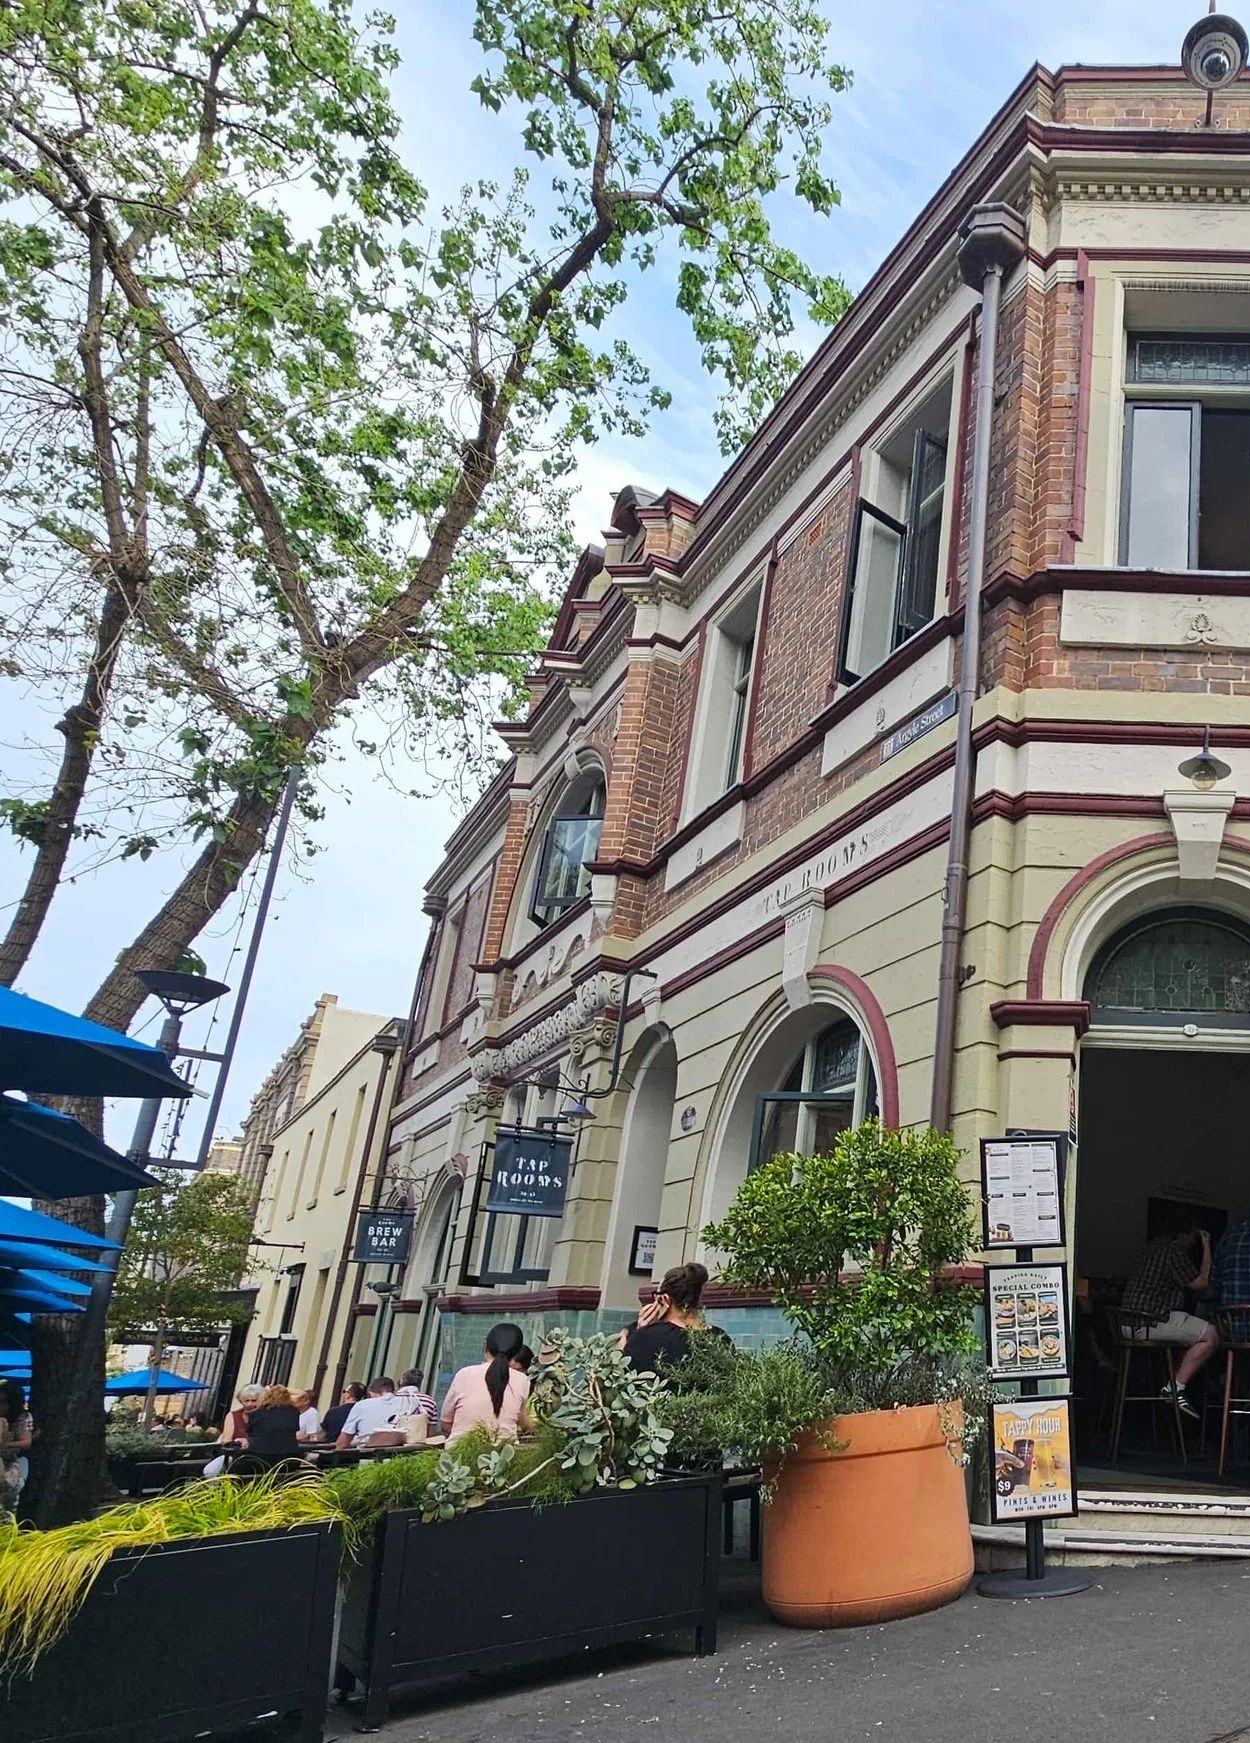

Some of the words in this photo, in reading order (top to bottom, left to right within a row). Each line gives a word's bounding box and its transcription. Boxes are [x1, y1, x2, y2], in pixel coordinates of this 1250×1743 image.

[921, 704, 944, 729] Street
[763, 882, 791, 914] TAP
[801, 832, 869, 890] ROOMS
[516, 1157, 548, 1172] TAP
[497, 1170, 562, 1188] ROOMS
[368, 1226, 403, 1236] BREW
[371, 1236, 396, 1247] BAR
[993, 1283, 1028, 1292] SPECIAL
[1003, 1418, 1034, 1437] TAPPY
[1036, 1417, 1061, 1435] HOUR
[997, 1481, 1011, 1493] $9
[1003, 1497, 1028, 1507] PINTS
[1041, 1493, 1067, 1503] WINES
